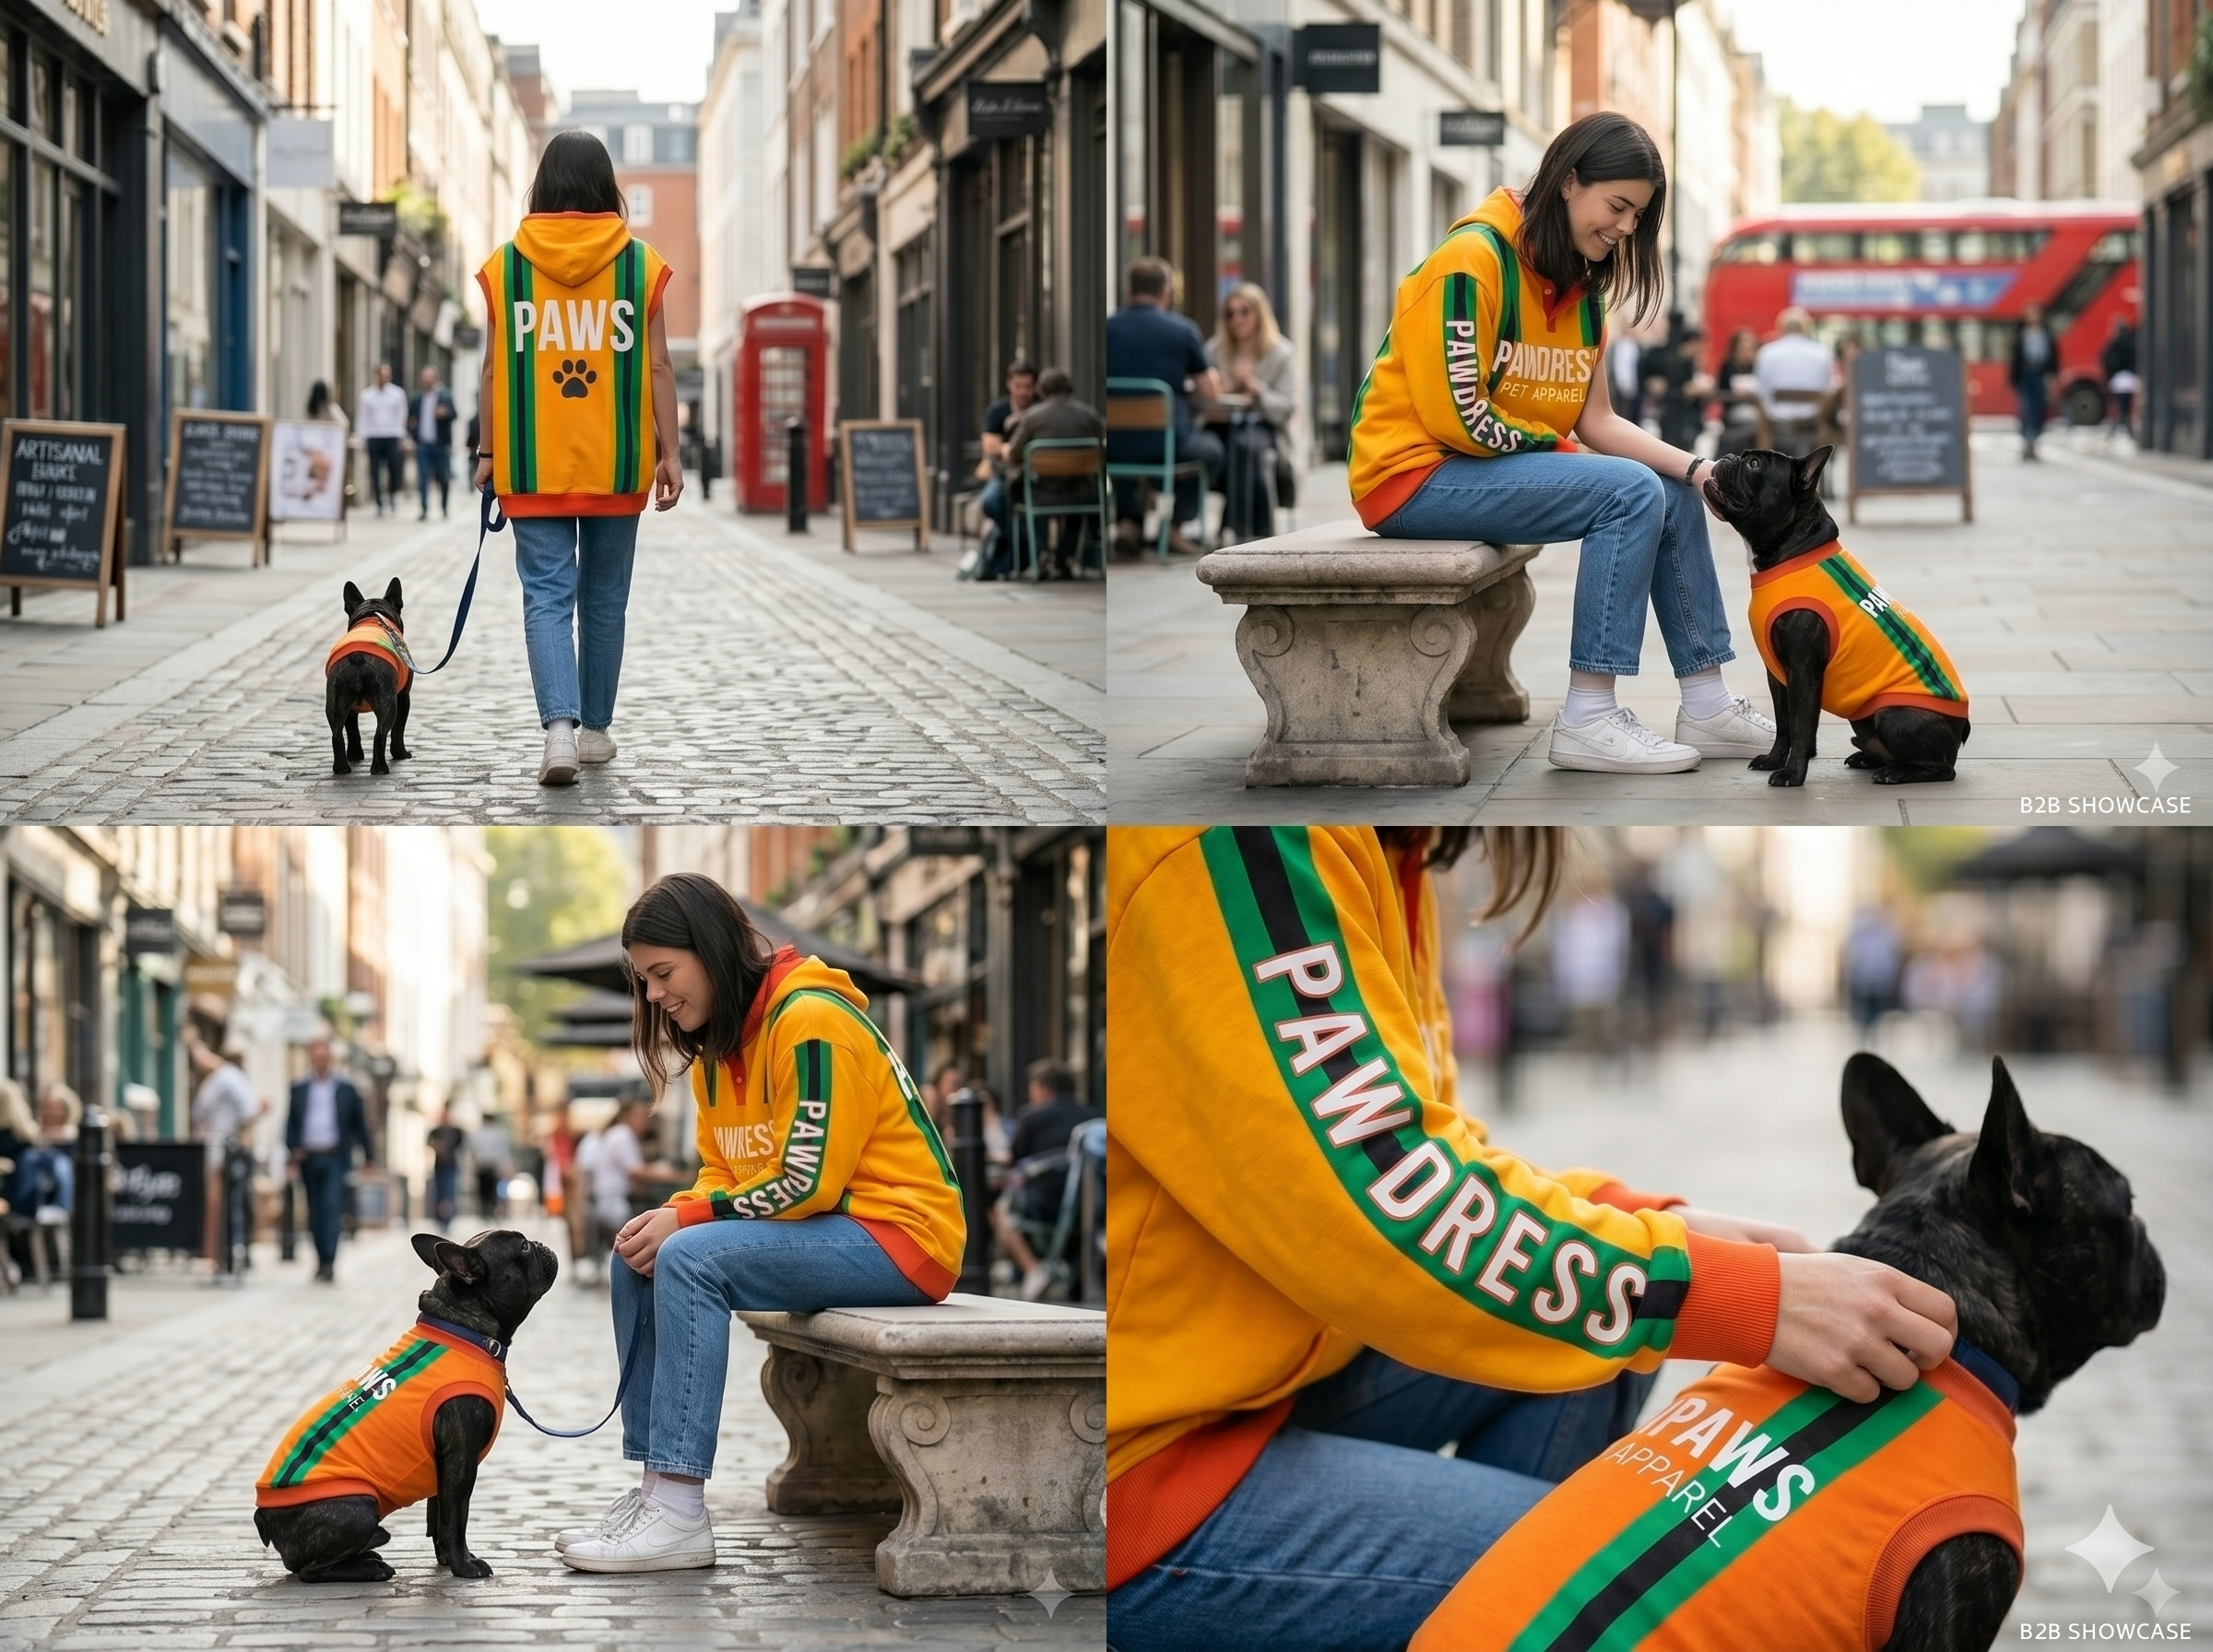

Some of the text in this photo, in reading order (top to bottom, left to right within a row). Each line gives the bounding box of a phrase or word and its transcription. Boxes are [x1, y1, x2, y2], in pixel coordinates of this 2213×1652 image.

[514, 299, 634, 352] PAWS
[1446, 320, 1522, 453] PAWDRESS
[1499, 382, 1586, 403] PET APPAREL
[15, 438, 104, 466] ARTISANAL
[1253, 941, 1648, 1346] PAWDRESS
[1604, 1442, 1734, 1549] APPAREL
